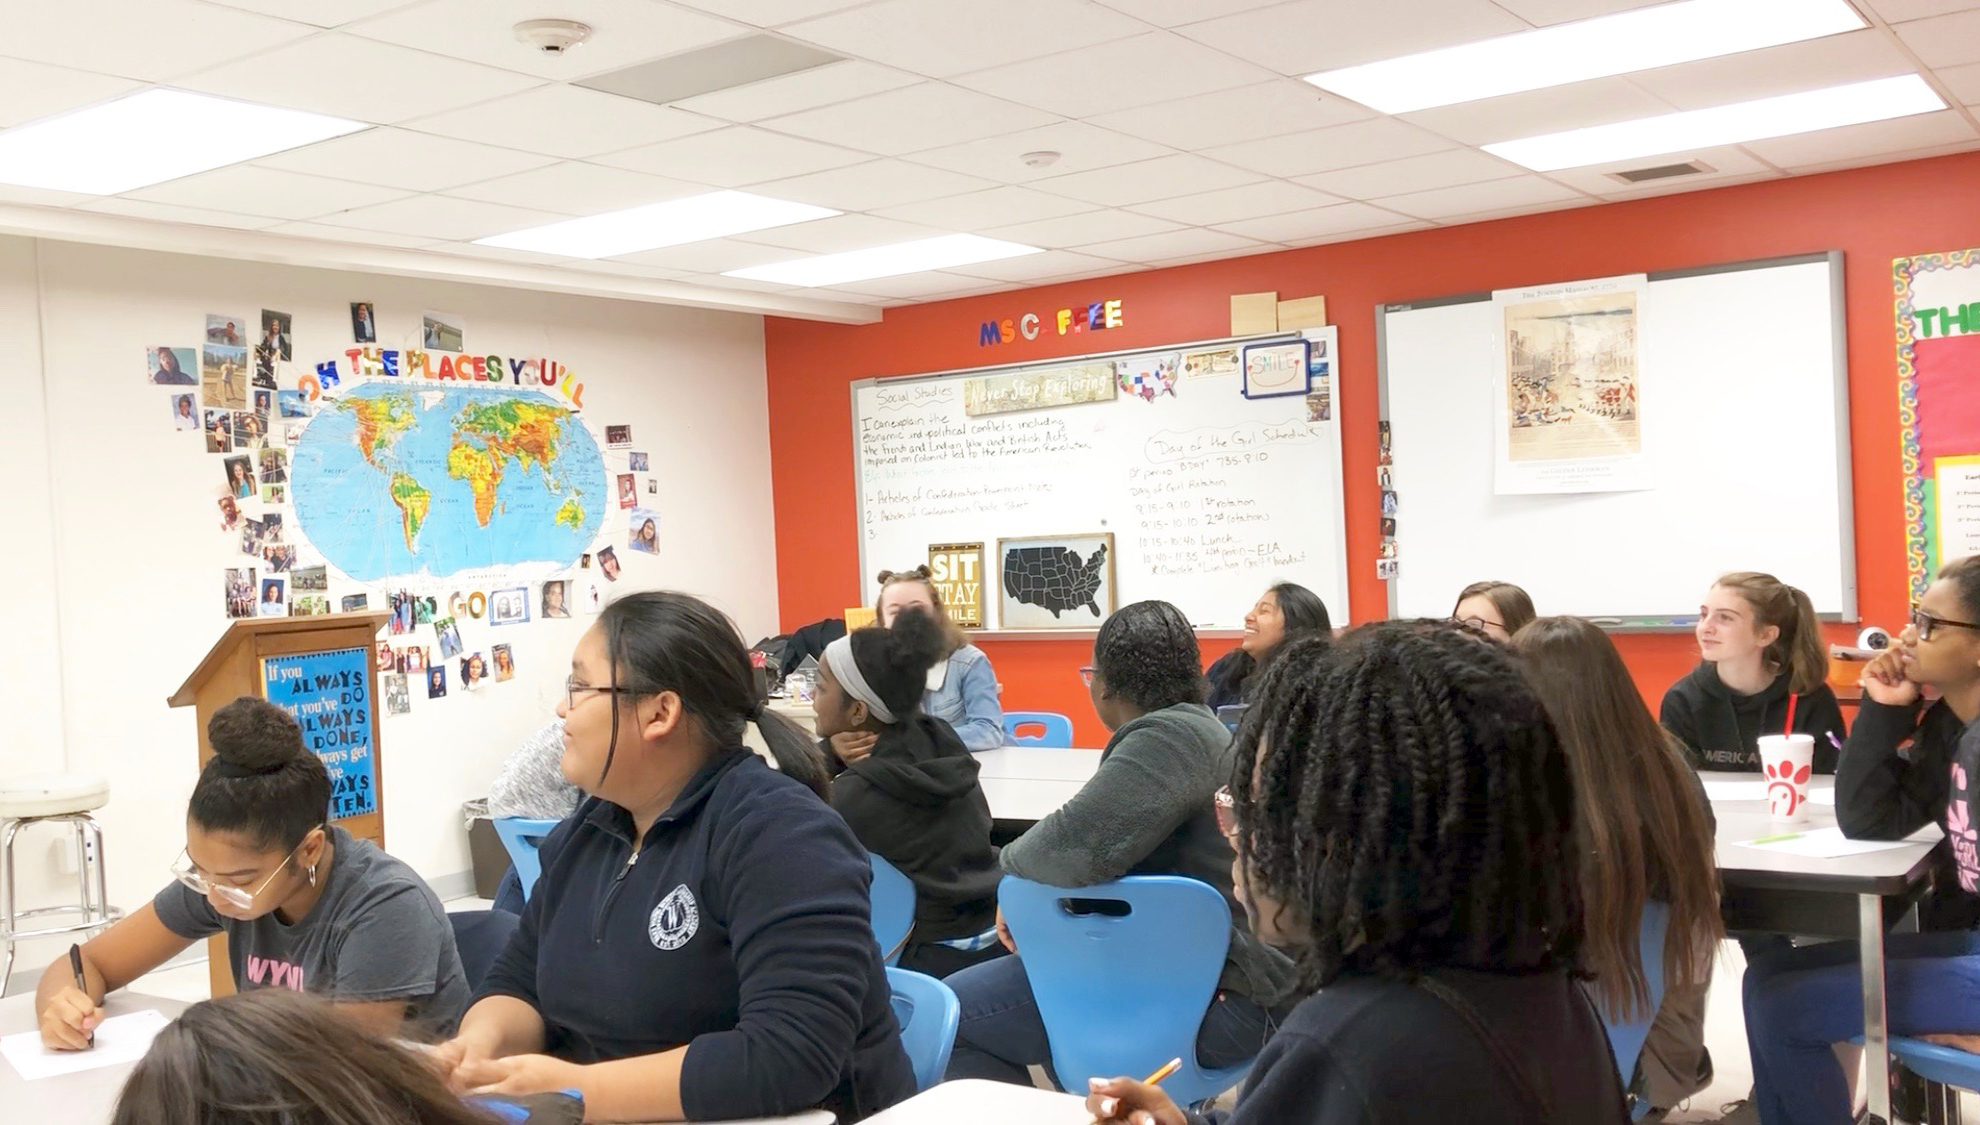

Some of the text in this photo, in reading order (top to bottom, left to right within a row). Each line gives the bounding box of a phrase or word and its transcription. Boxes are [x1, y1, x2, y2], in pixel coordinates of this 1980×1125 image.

[979, 299, 1124, 347] MS CFFEE
[1252, 352, 1295, 374] SMILE
[297, 347, 584, 409] OH THE PLACES YOU'LL
[876, 386, 953, 406] Social Studies
[971, 374, 1108, 408] Never Stop Exploring
[929, 414, 949, 424] the
[863, 446, 878, 456] the
[909, 442, 925, 454] and
[986, 436, 1006, 447] and
[1154, 440, 1185, 458] Day
[1190, 436, 1202, 452] of
[1211, 434, 1228, 447] the
[932, 553, 979, 582] SIT
[448, 591, 487, 619] GO
[268, 665, 303, 682] If you
[291, 670, 363, 695] ALWAYS
[340, 687, 365, 705] DO
[280, 697, 338, 718] hat you've
[313, 729, 368, 750] DONE,
[316, 745, 368, 765] lways get
[1703, 750, 1758, 764] MERICA
[332, 791, 372, 814] TEN.
